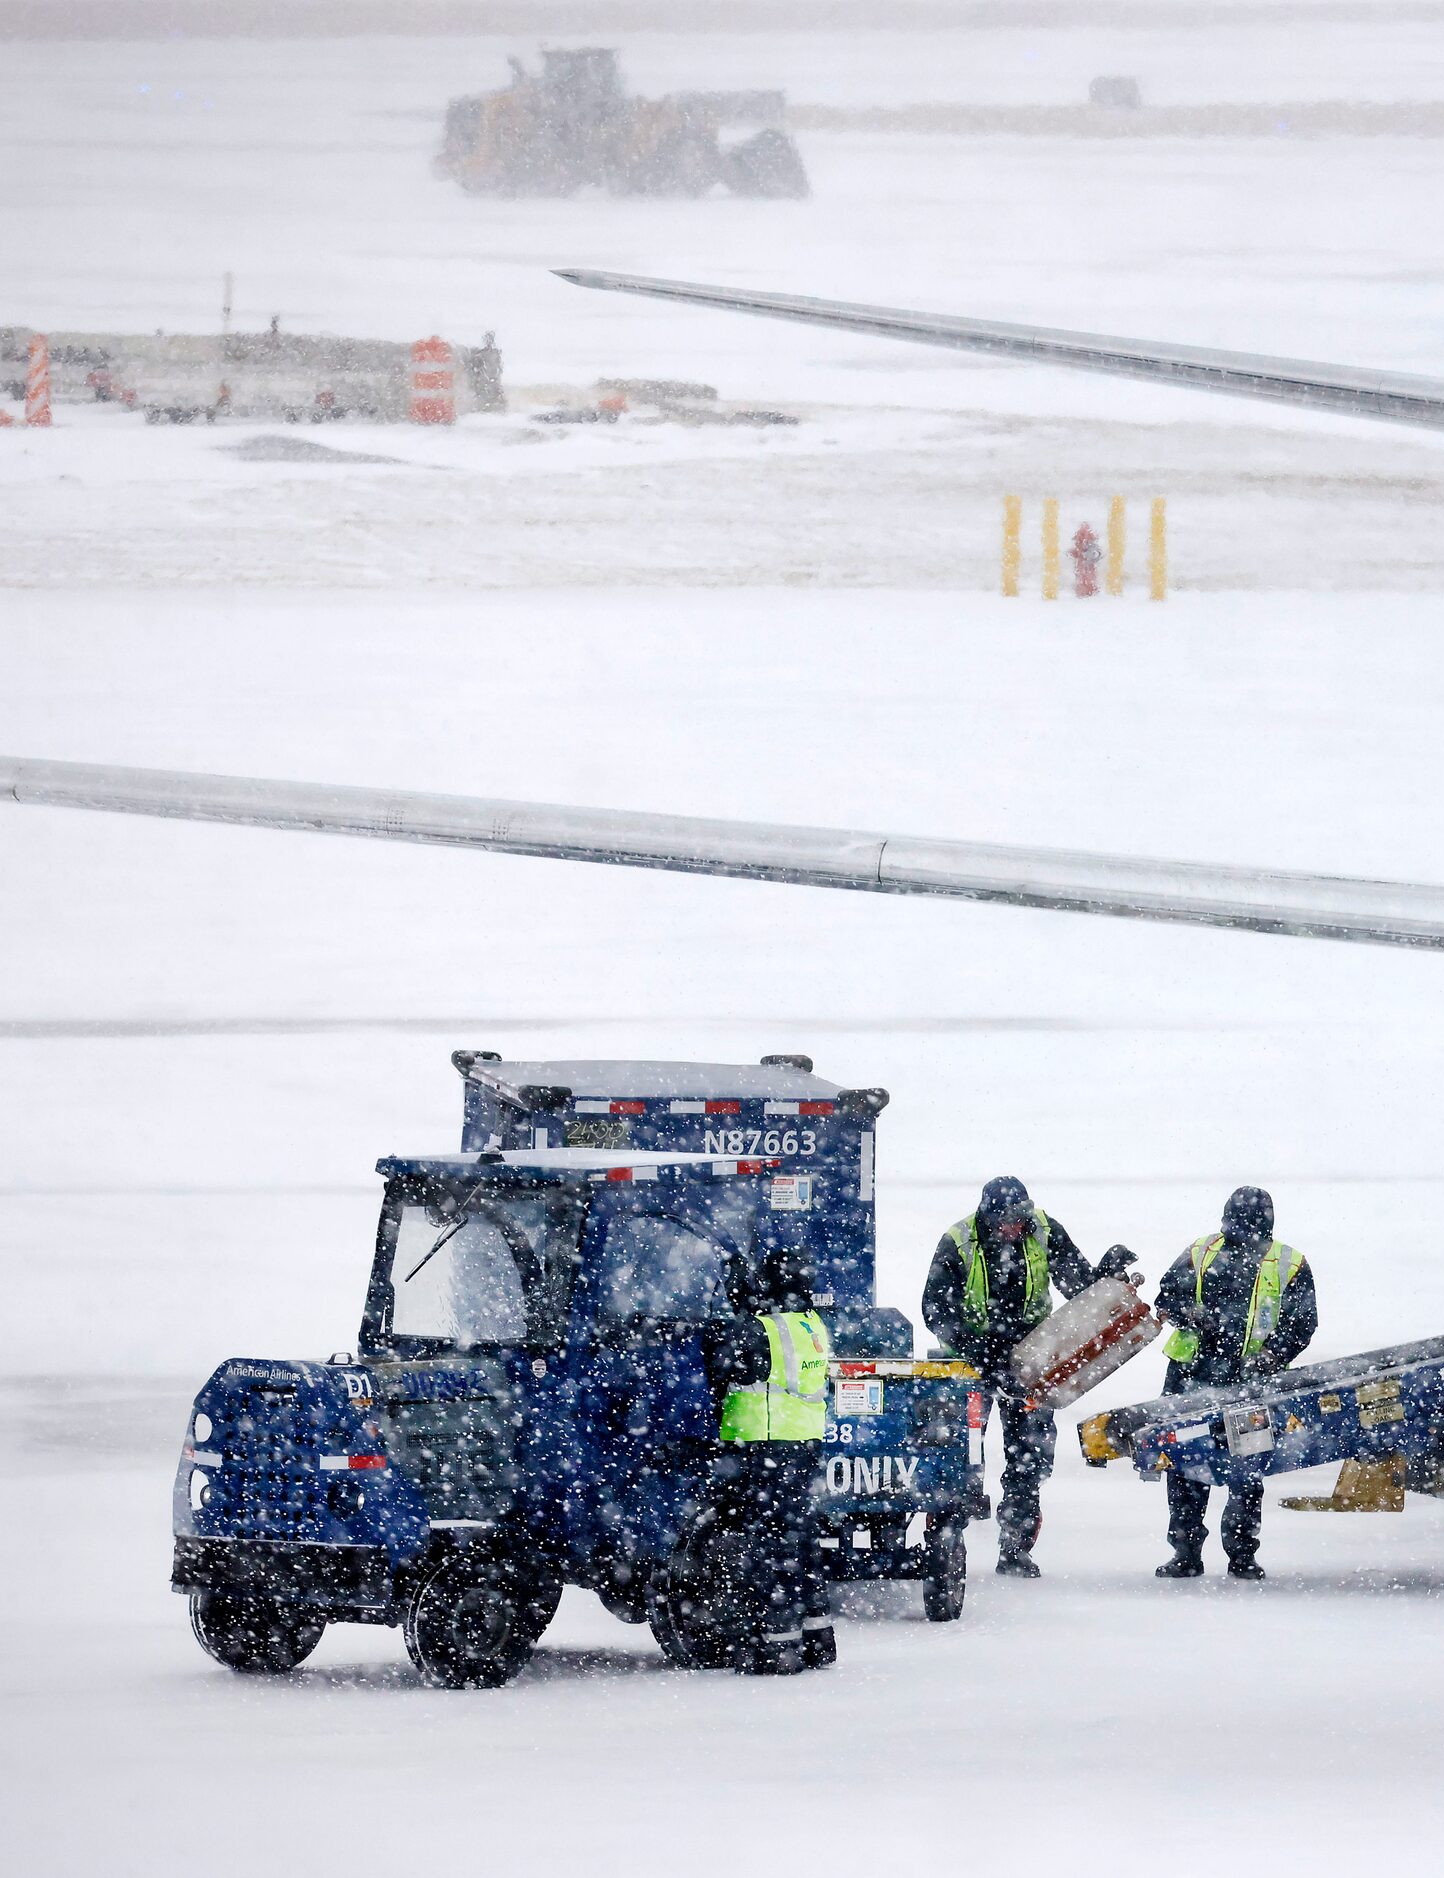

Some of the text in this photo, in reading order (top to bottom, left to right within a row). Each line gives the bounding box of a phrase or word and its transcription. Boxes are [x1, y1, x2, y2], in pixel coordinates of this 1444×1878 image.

[705, 1129, 816, 1155] N87663
[226, 1364, 300, 1382] American Airlines
[343, 1373, 372, 1398] D1
[822, 1423, 853, 1444] 38
[827, 1456, 919, 1495] ONLY
